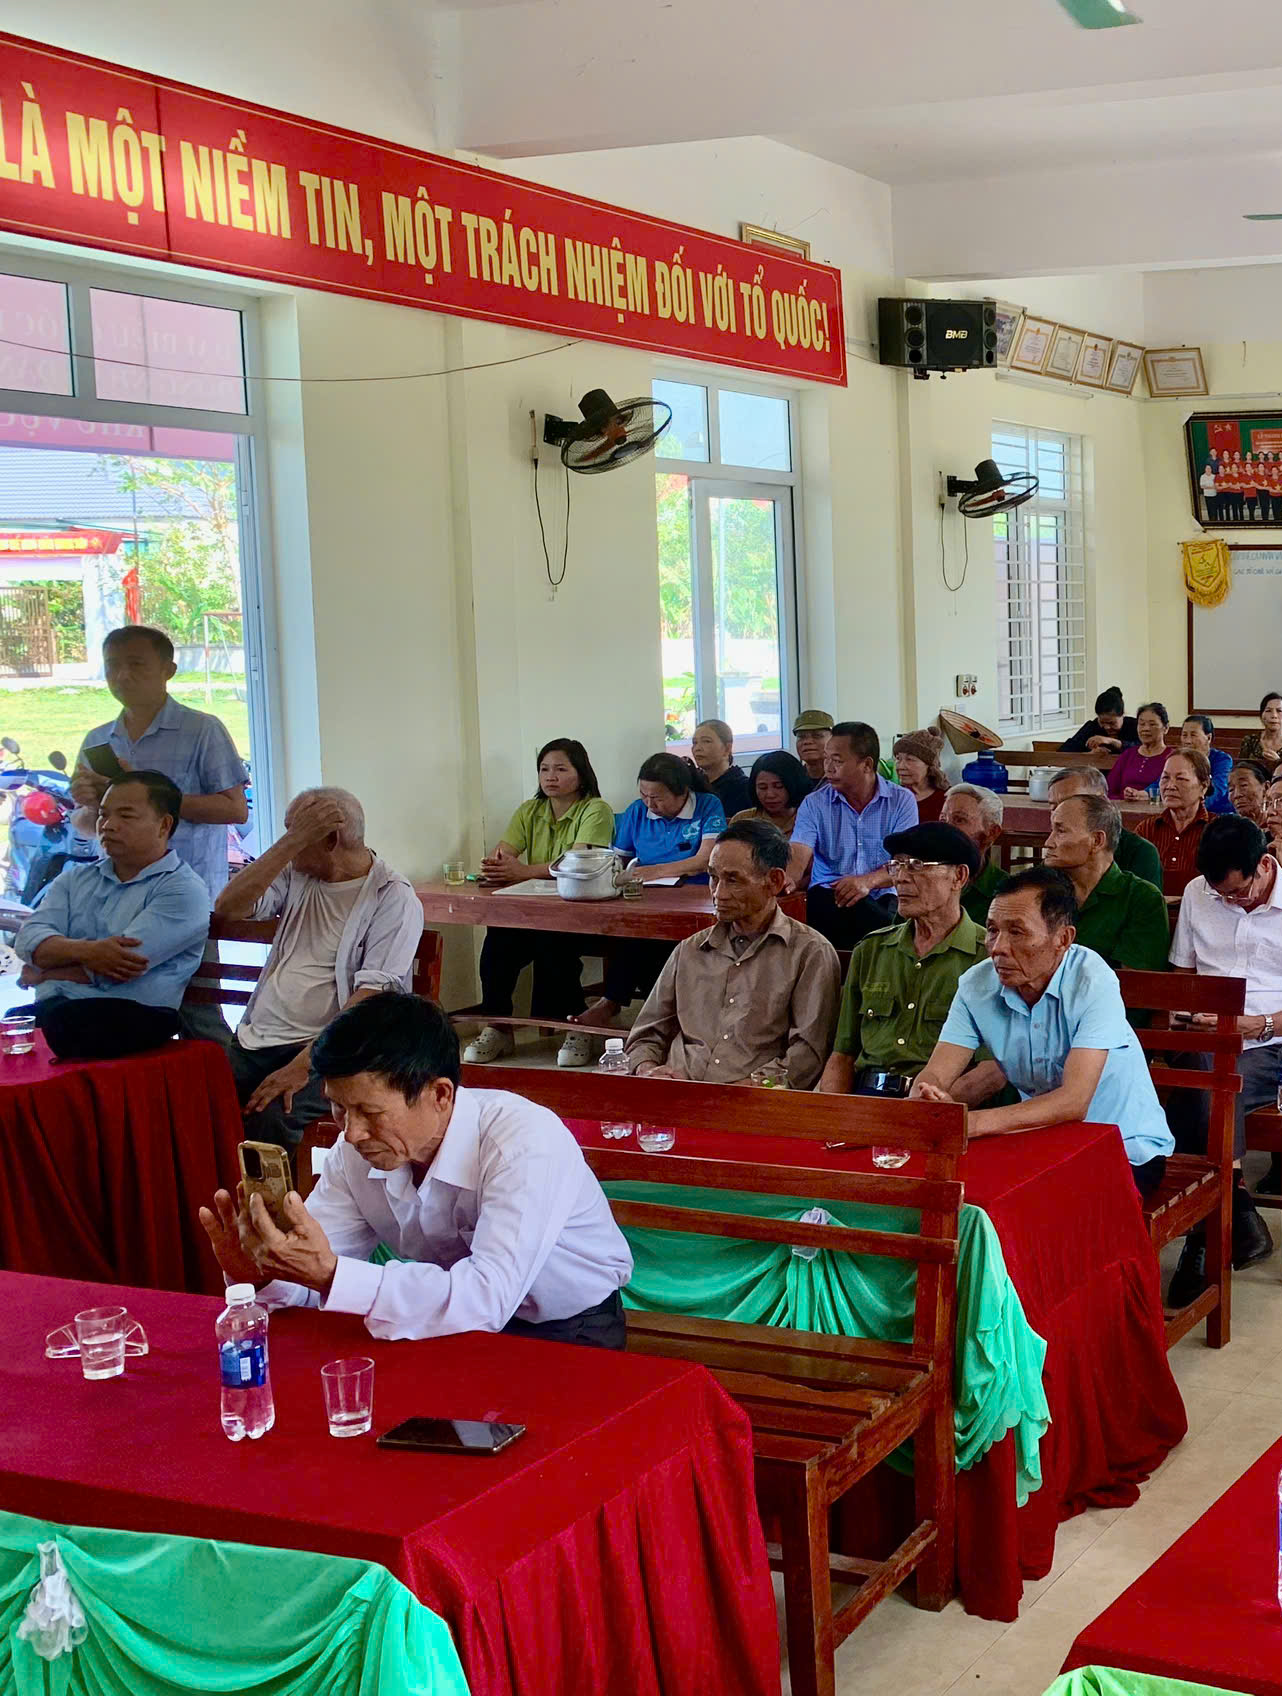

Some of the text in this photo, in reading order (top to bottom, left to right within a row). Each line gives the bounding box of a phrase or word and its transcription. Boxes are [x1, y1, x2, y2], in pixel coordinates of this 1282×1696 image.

[0, 81, 831, 353] LÀ MỘT NIỀM TIN, MỘT TRÁCH NHIỆM ĐỐI VỚI TỔ QUỐC!
[945, 330, 968, 339] BMB
